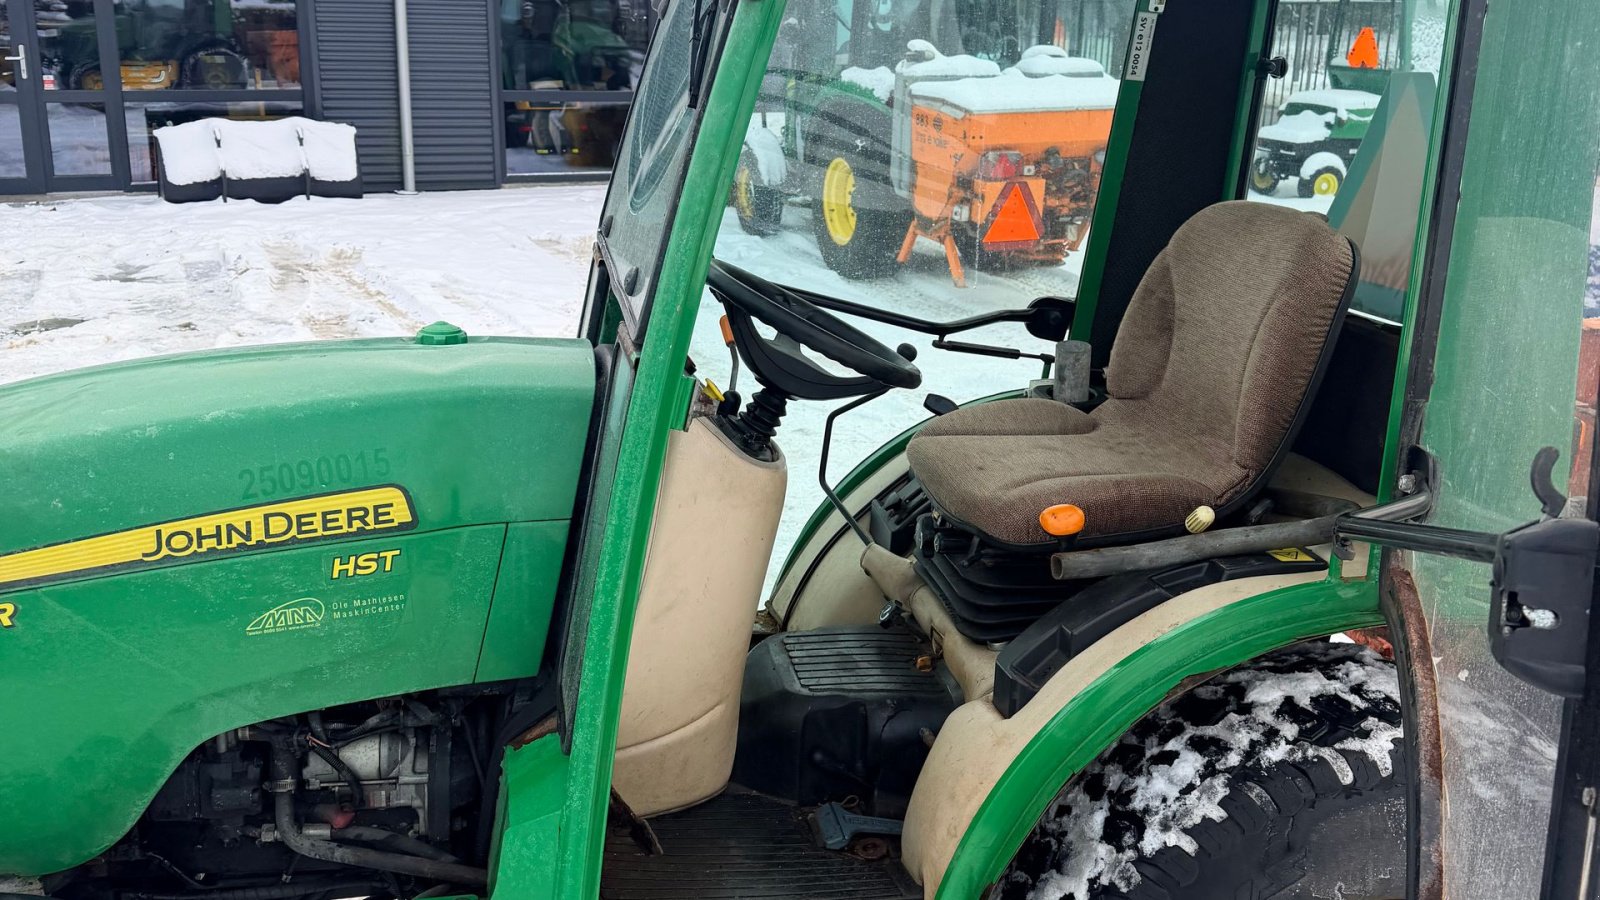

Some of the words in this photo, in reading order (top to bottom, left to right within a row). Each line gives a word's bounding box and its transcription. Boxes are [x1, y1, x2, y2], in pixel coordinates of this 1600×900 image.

[1131, 53, 1140, 76] 0054
[238, 448, 391, 500] 25090015
[141, 520, 253, 559] JOHN
[262, 502, 396, 540] DEERE
[331, 549, 401, 580] HST
[332, 601, 348, 610] Ole
[353, 594, 405, 607] Mathiesen
[333, 603, 405, 619] MaskinCenter
